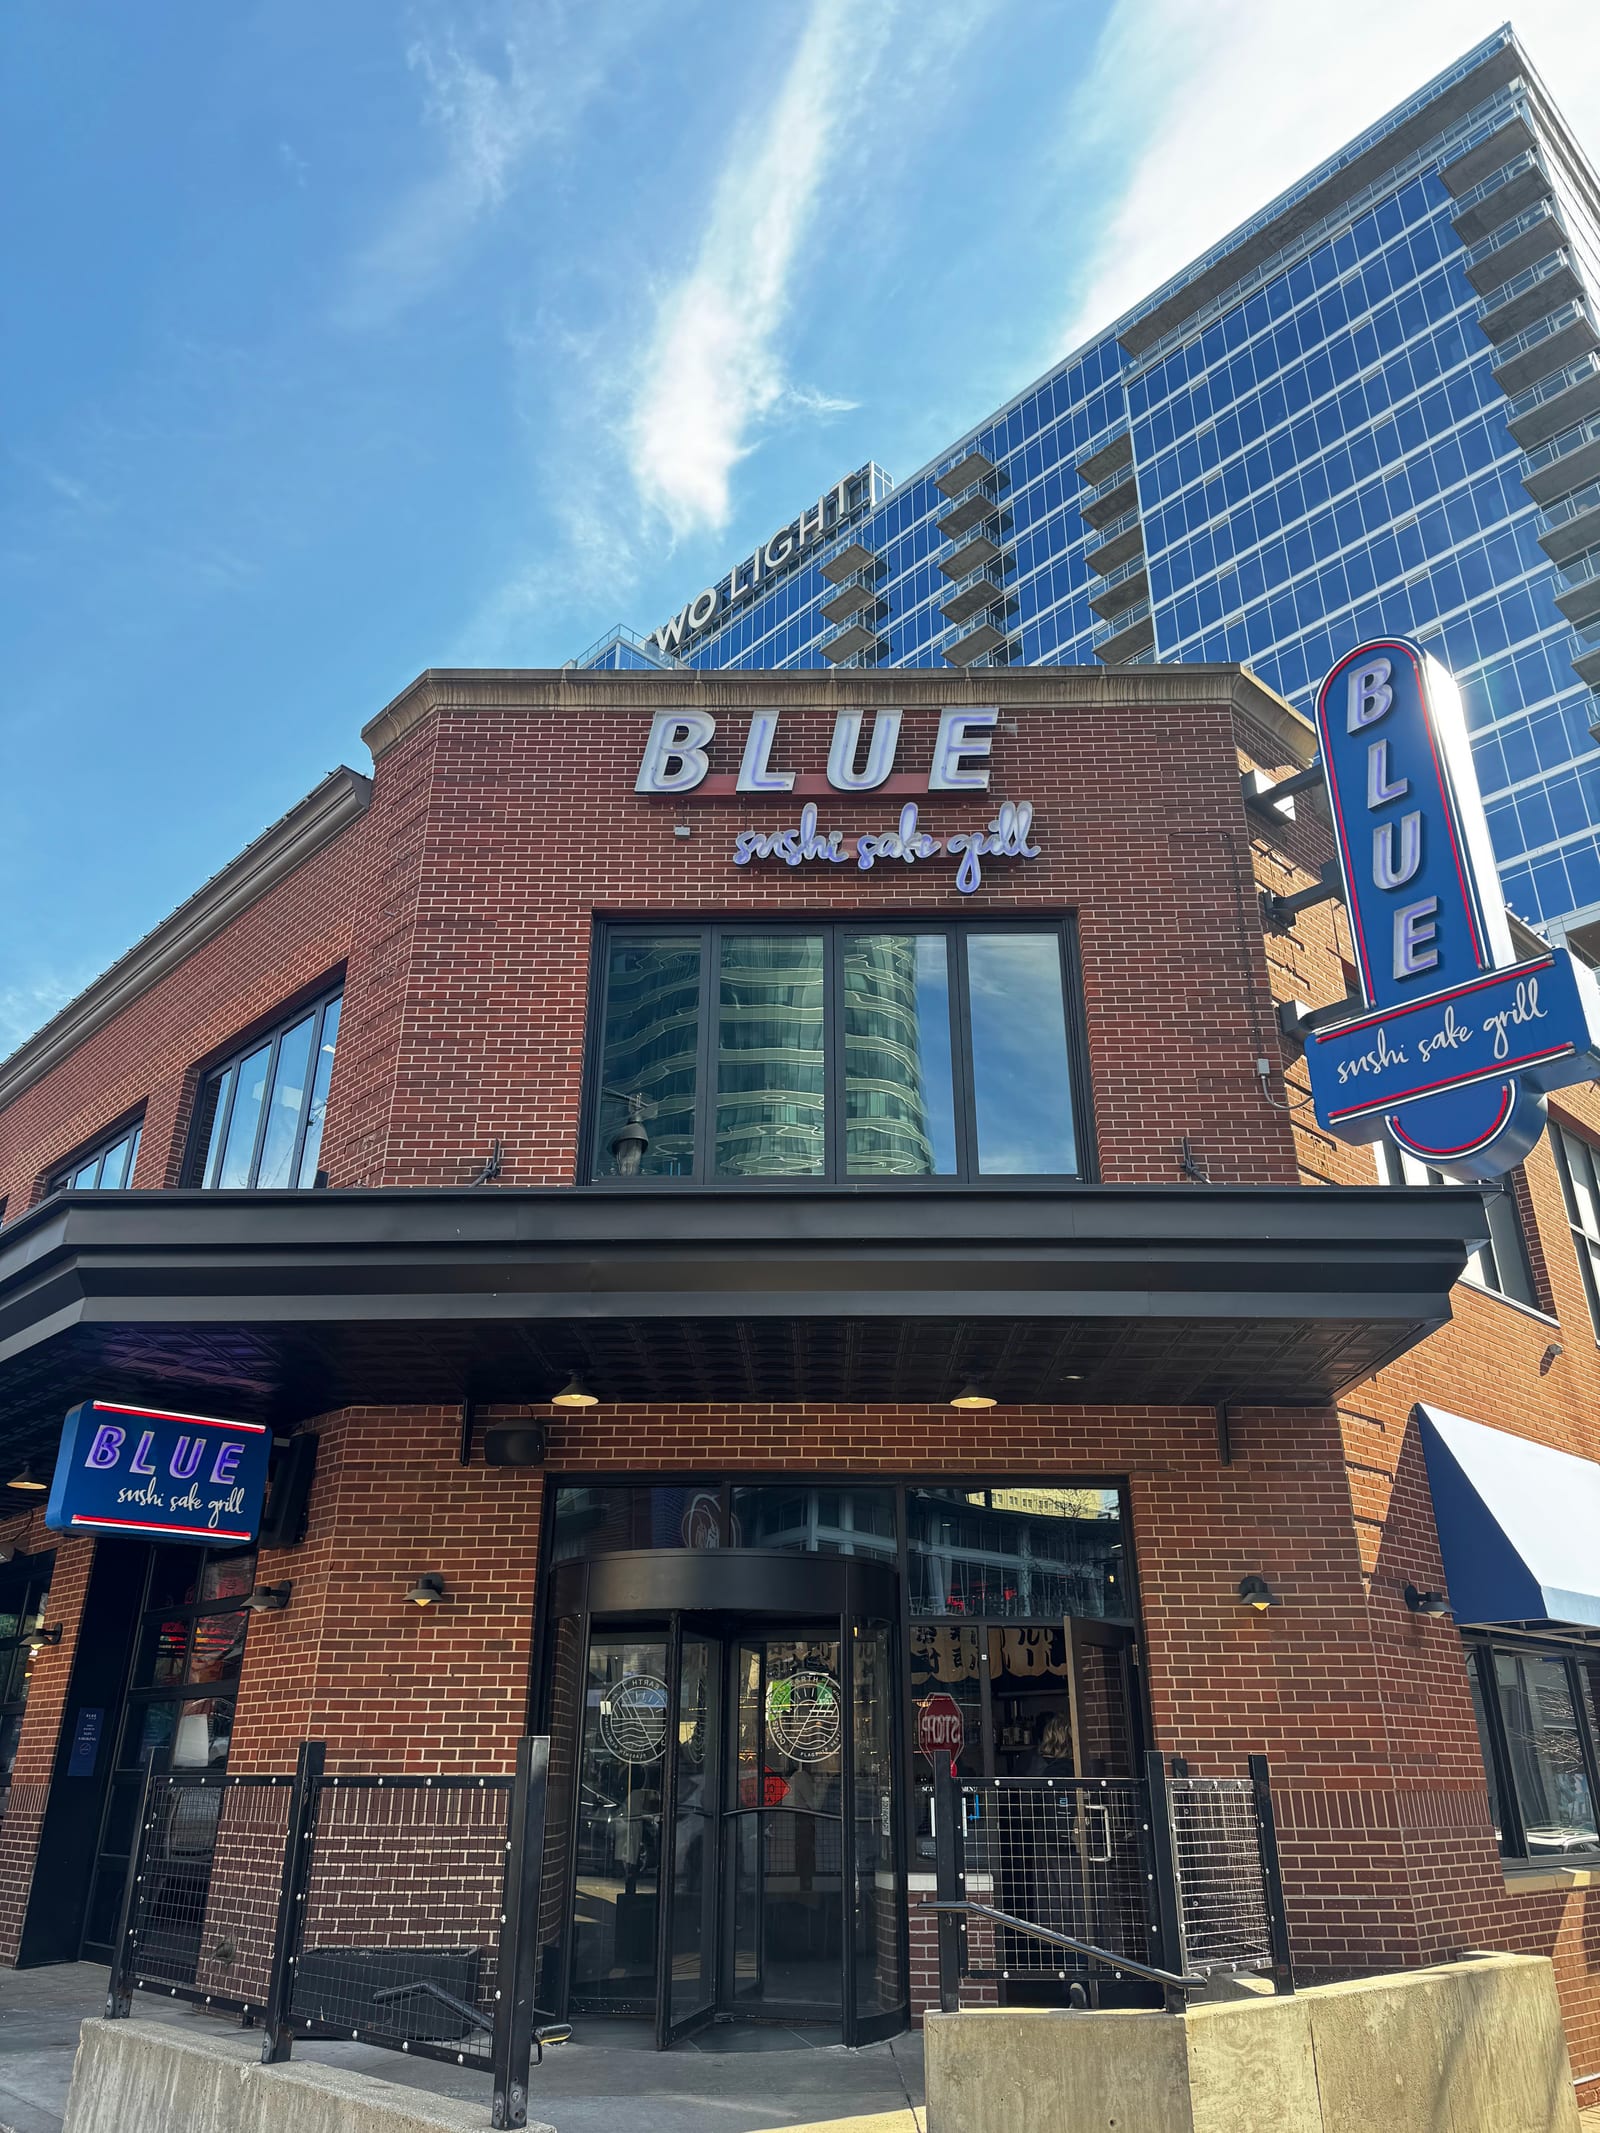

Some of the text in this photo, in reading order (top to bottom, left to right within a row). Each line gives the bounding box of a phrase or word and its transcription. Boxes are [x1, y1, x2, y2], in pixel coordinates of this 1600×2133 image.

[652, 471, 858, 651] WO LIGHT
[634, 707, 999, 796] BLUE
[733, 801, 1041, 894] sushi sake grill
[1347, 657, 1440, 980] BLUE
[1337, 976, 1548, 1085] sushi sake grill
[84, 1424, 245, 1485] BLUE
[117, 1477, 244, 1528] sushi sake grill
